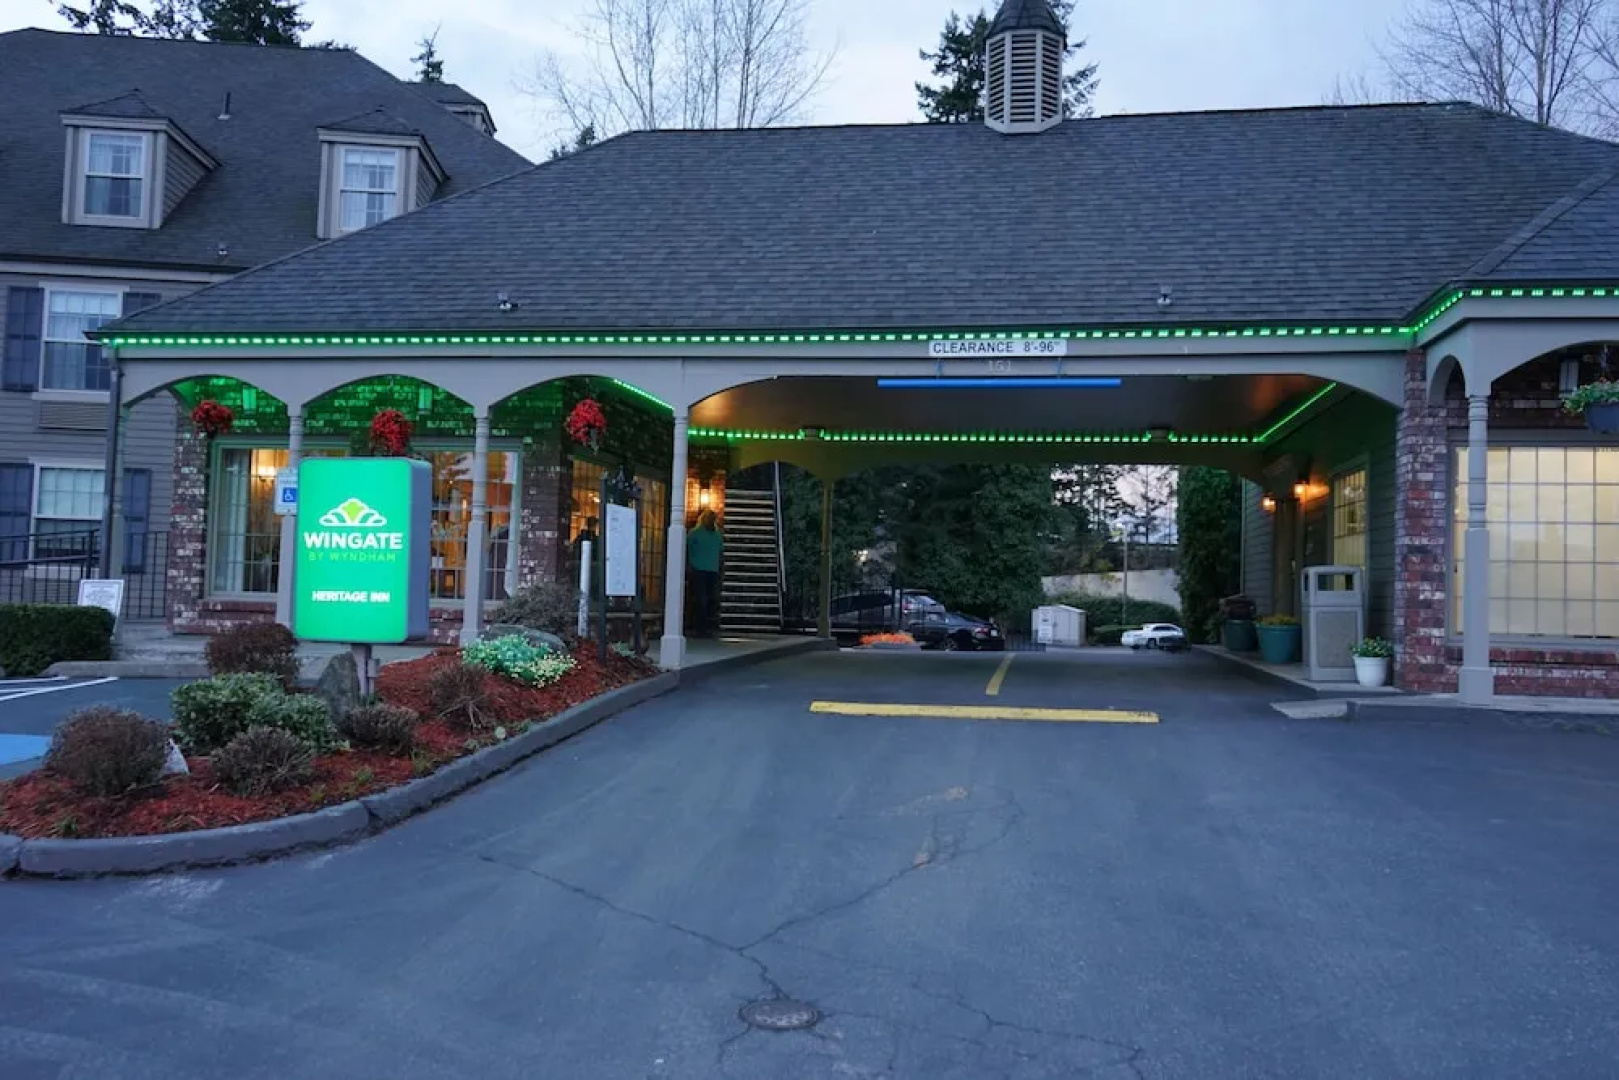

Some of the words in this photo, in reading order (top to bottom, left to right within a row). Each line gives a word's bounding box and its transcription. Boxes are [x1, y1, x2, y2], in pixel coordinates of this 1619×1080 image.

[932, 341, 1015, 354] CLEARANCE
[303, 532, 403, 550] WINGATE
[308, 551, 325, 561] BY
[330, 551, 396, 562] WYNDHAM
[311, 590, 369, 602] HERITAGE
[370, 591, 391, 603] INN
